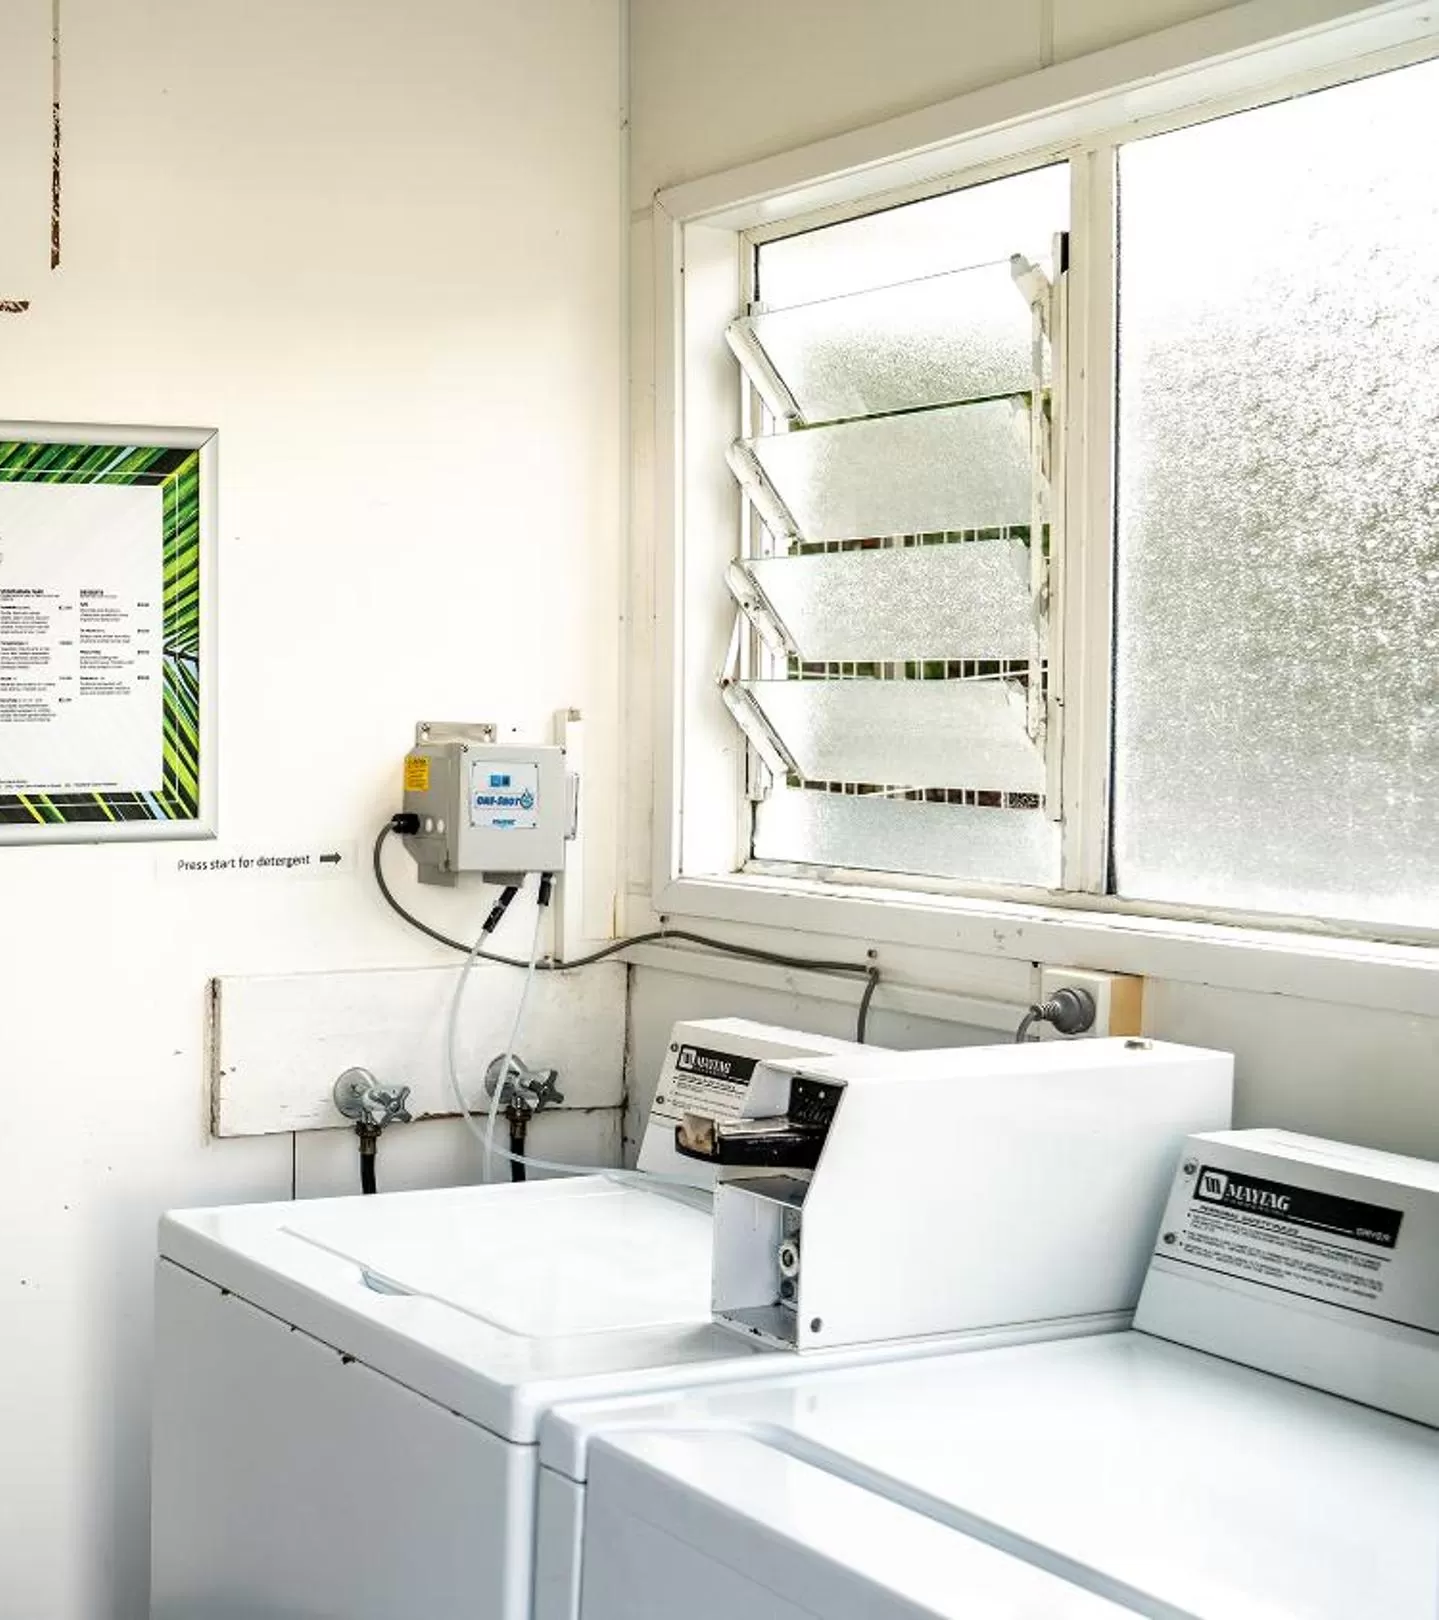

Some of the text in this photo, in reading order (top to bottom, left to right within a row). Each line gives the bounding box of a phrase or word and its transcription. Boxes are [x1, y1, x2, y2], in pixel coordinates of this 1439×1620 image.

[177, 854, 311, 872] Press start for detergent
[1225, 1182, 1291, 1212] MAYTAG
